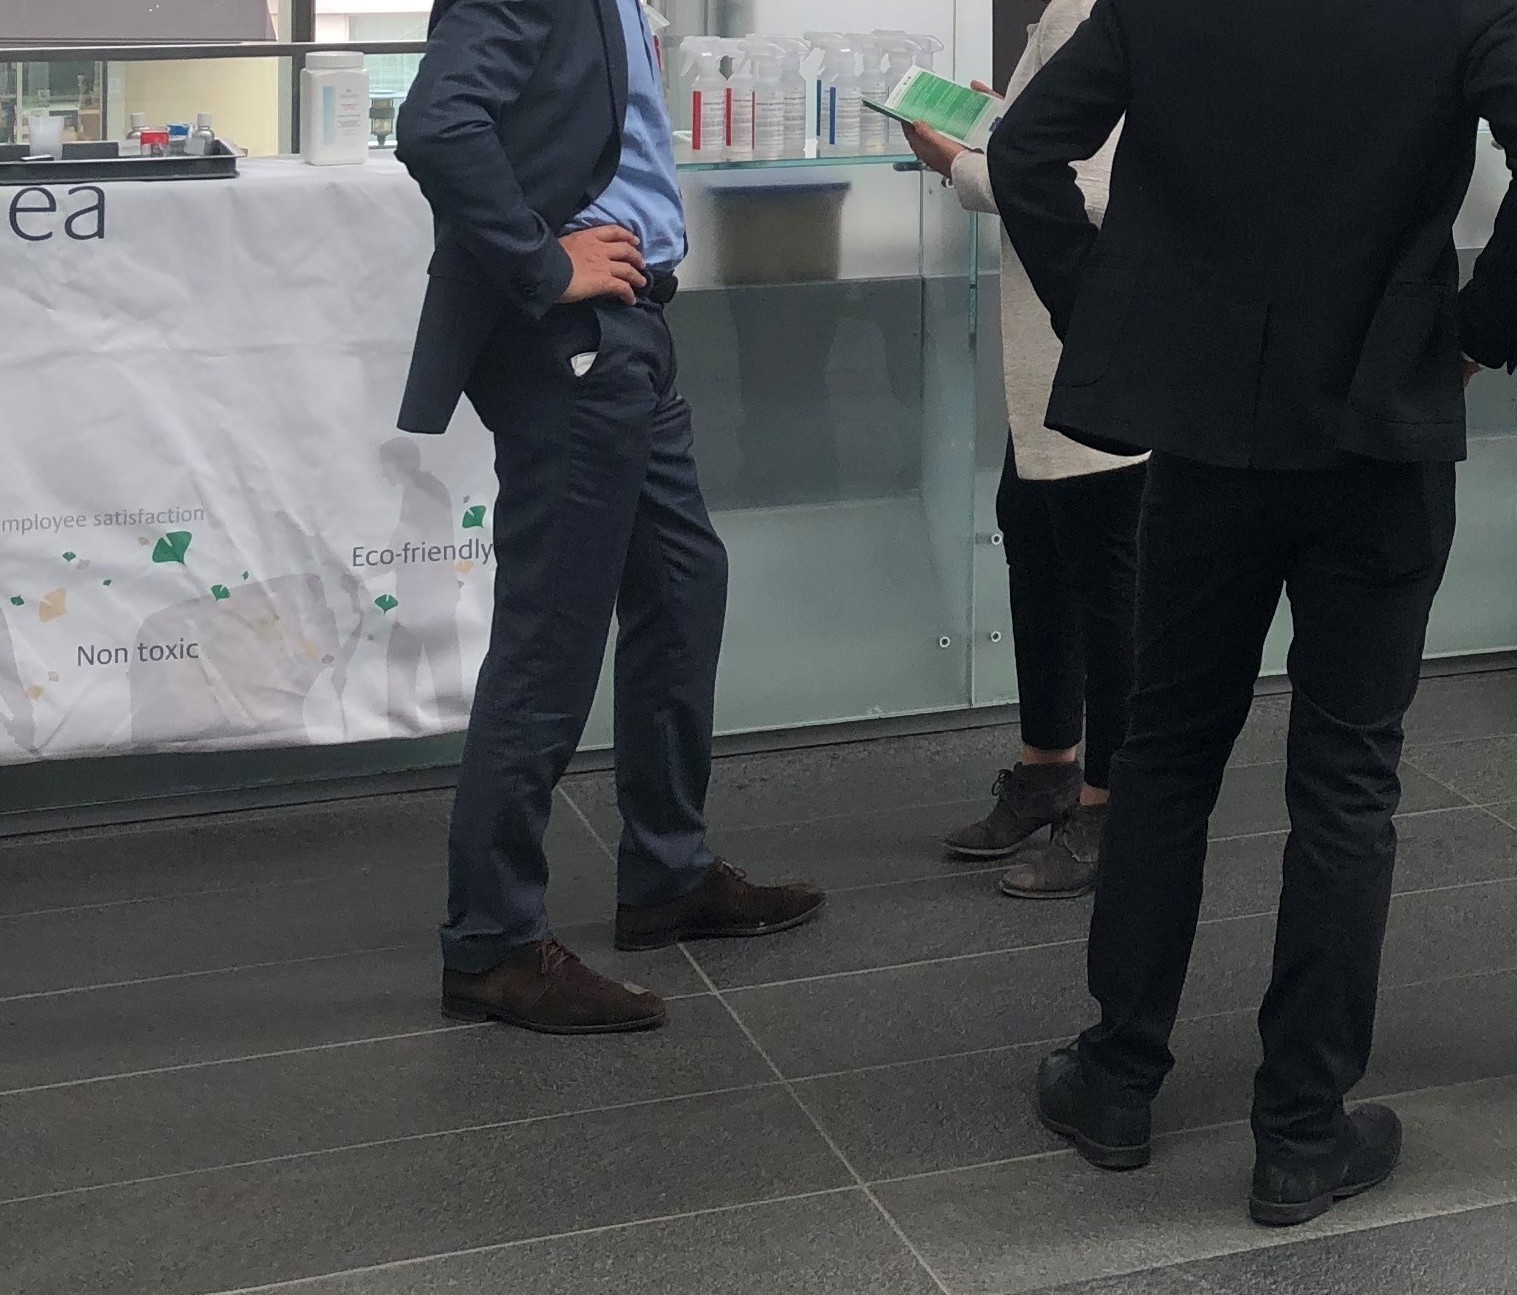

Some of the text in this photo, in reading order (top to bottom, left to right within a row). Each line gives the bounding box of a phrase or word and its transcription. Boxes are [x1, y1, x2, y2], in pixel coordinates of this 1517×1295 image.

[9, 185, 105, 241] ea
[0, 506, 205, 535] mployee satisfaction
[352, 537, 494, 567] Eco-friendly
[77, 637, 200, 667] Non toxic
